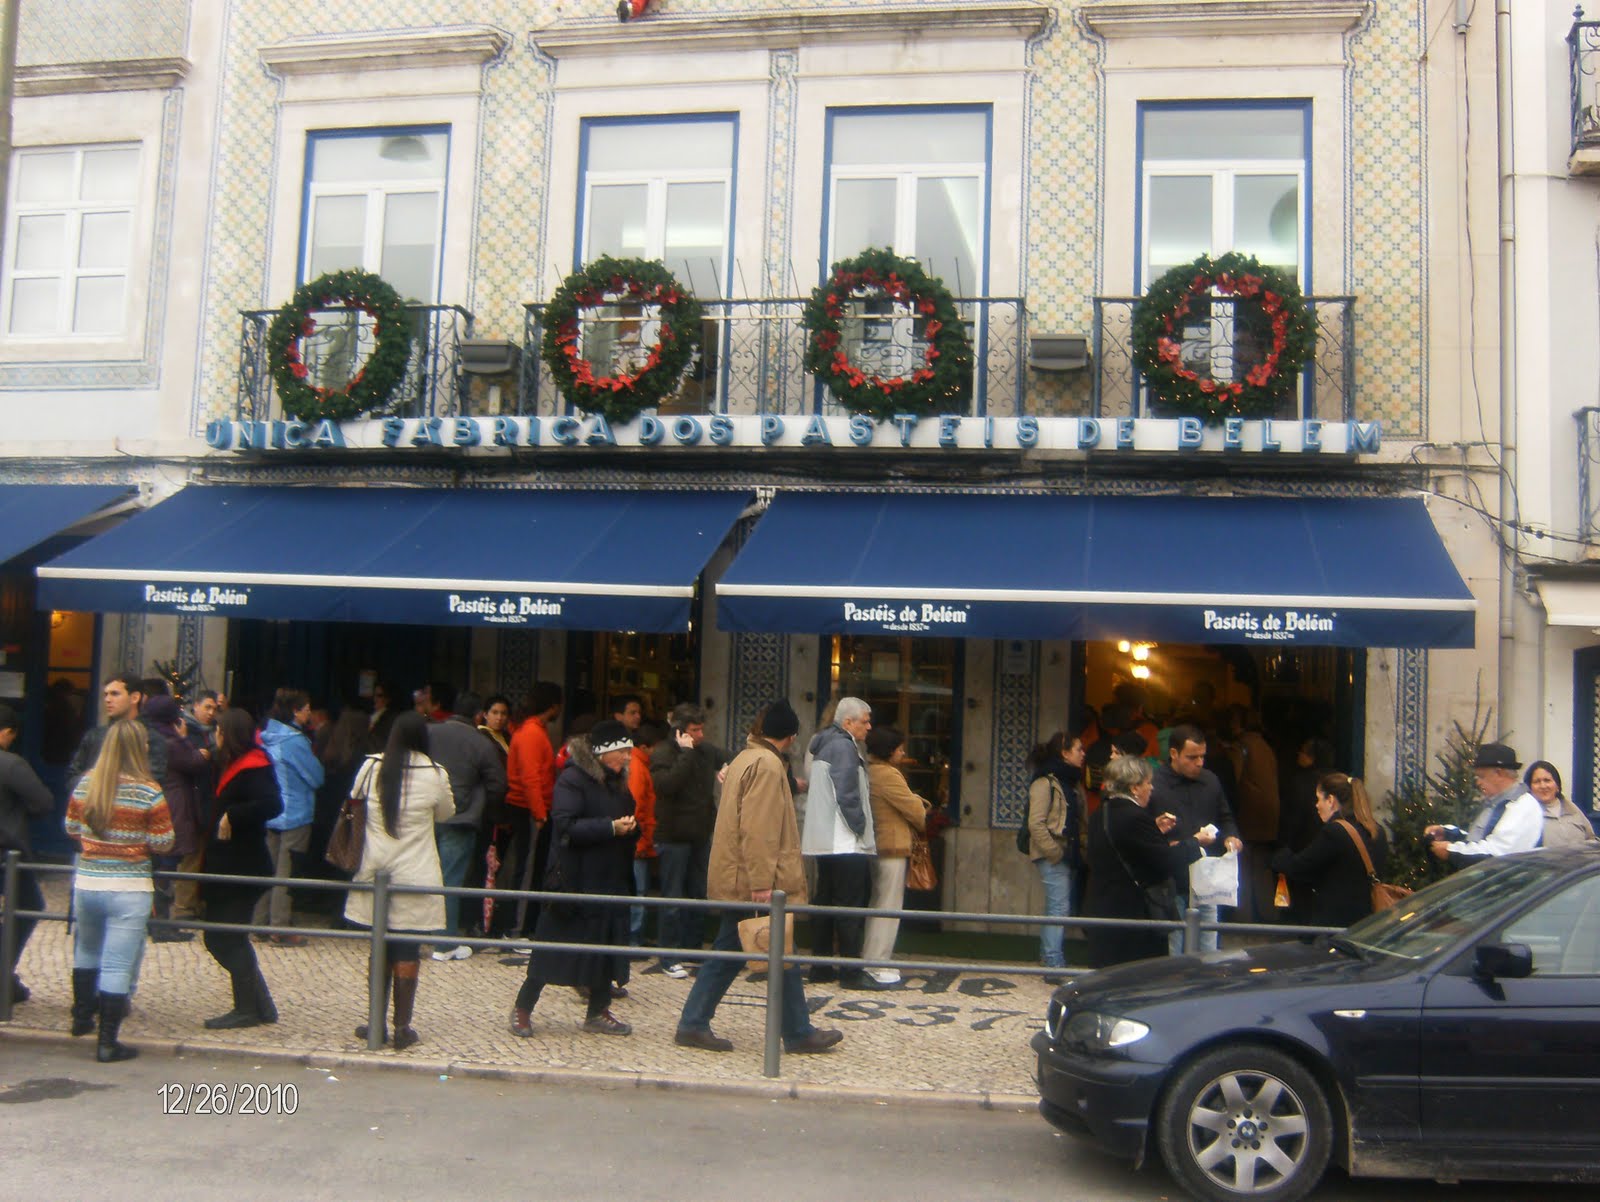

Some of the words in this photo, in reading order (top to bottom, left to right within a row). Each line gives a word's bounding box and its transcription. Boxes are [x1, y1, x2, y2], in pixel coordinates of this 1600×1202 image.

[638, 413, 733, 446] DOS
[760, 414, 1039, 449] PASTEIS
[1077, 417, 1135, 451] DE
[1178, 417, 1381, 454] BELEM
[191, 588, 206, 604] de
[449, 594, 497, 614] Pastéis
[499, 598, 517, 614] de
[519, 596, 562, 615] Belém
[844, 602, 897, 621] Pastéis
[899, 605, 918, 622] de
[921, 603, 967, 623] Belém
[1203, 609, 1259, 631] Pastéis
[1262, 613, 1281, 631] de
[1285, 611, 1334, 631] Belém
